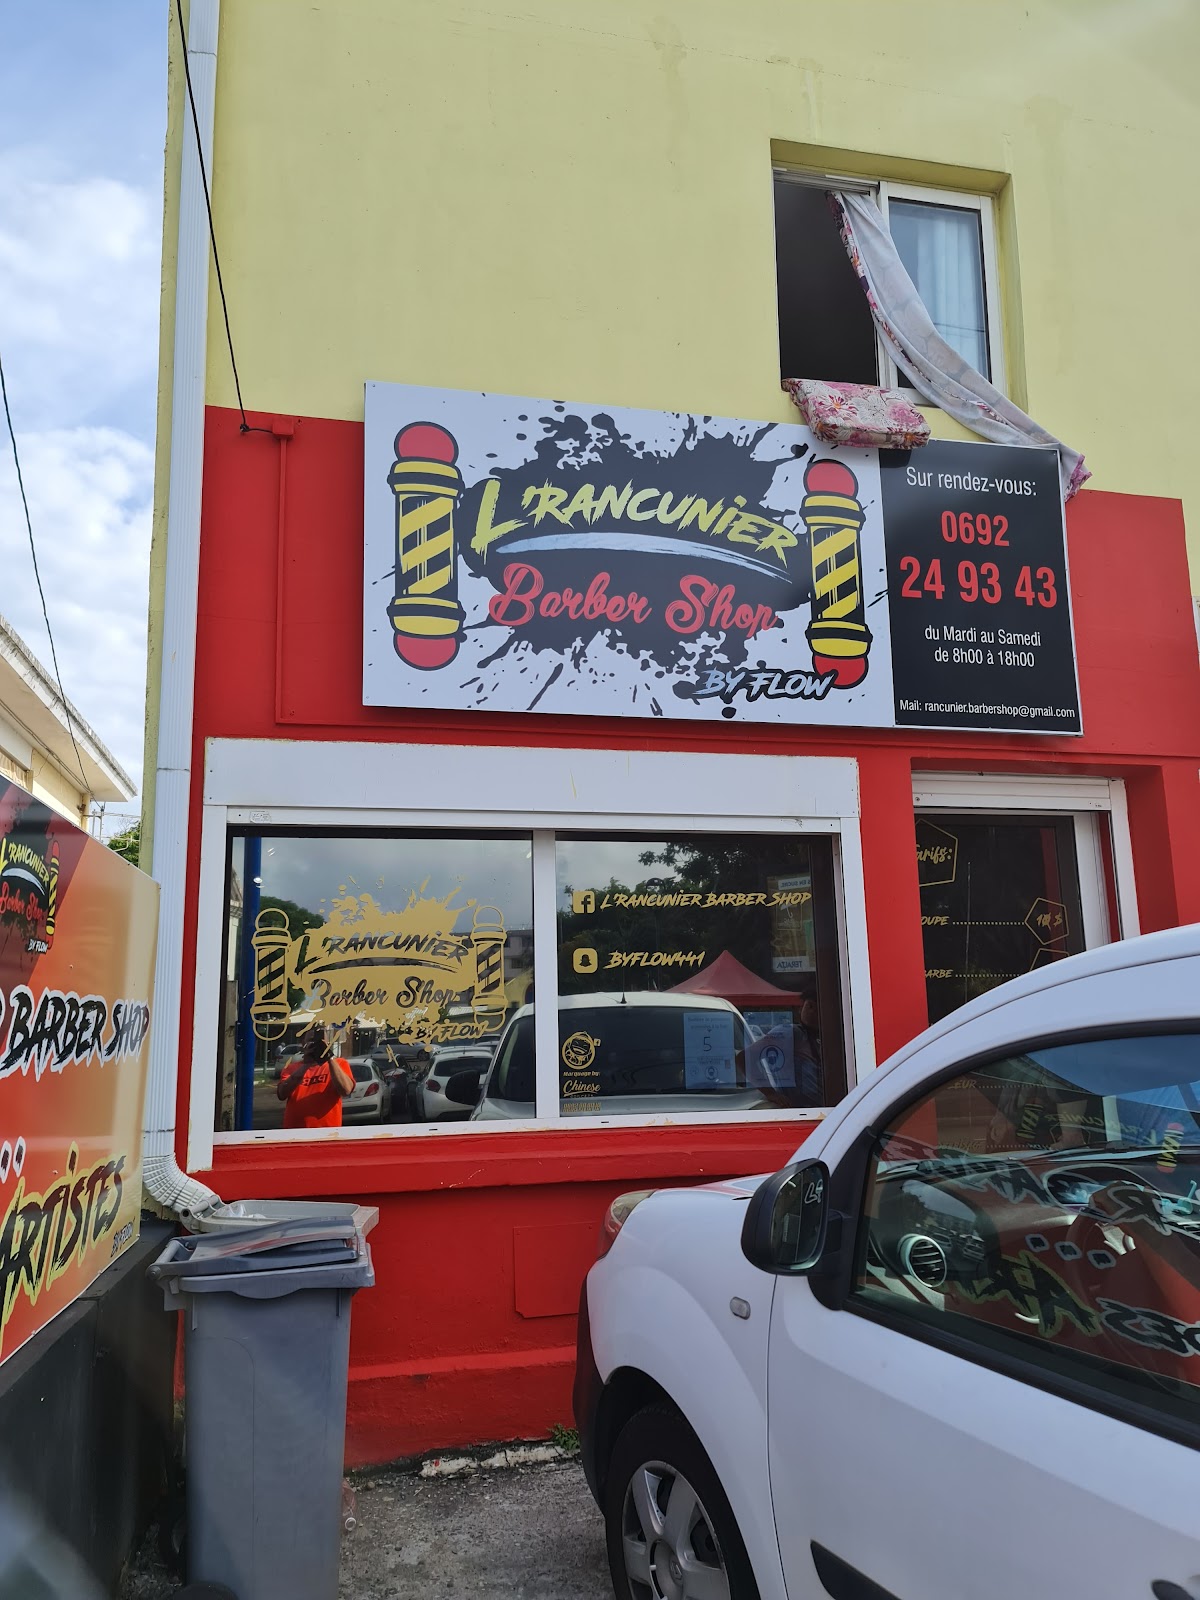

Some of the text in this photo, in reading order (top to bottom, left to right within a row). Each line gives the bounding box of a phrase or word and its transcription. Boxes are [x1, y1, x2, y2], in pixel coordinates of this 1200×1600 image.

[906, 466, 1037, 496] Sur rendez-vous:
[941, 510, 1010, 547] 0692
[900, 556, 1058, 608] 24 93 43
[488, 563, 778, 639] Barber Shop
[924, 624, 1042, 647] du Mardi au Samedi
[934, 647, 1035, 667] de 8h00 à 18h00
[693, 668, 833, 698] BY FLOW
[899, 699, 1076, 720] Mail: rancunier.barbershop@gmail.com
[916, 844, 953, 865] arifs:
[700, 891, 768, 909] BARBER
[764, 891, 812, 911] SHOP
[920, 915, 950, 926] OUPE
[602, 950, 706, 970] BYFLOW441
[925, 969, 954, 979] ARBE
[301, 976, 458, 1013] Barber Shop
[0, 988, 107, 1076] BARBER
[103, 1000, 150, 1062] SHOP
[440, 1024, 486, 1038] FLOW
[702, 1036, 713, 1052] 5
[563, 1079, 602, 1095] Chinese
